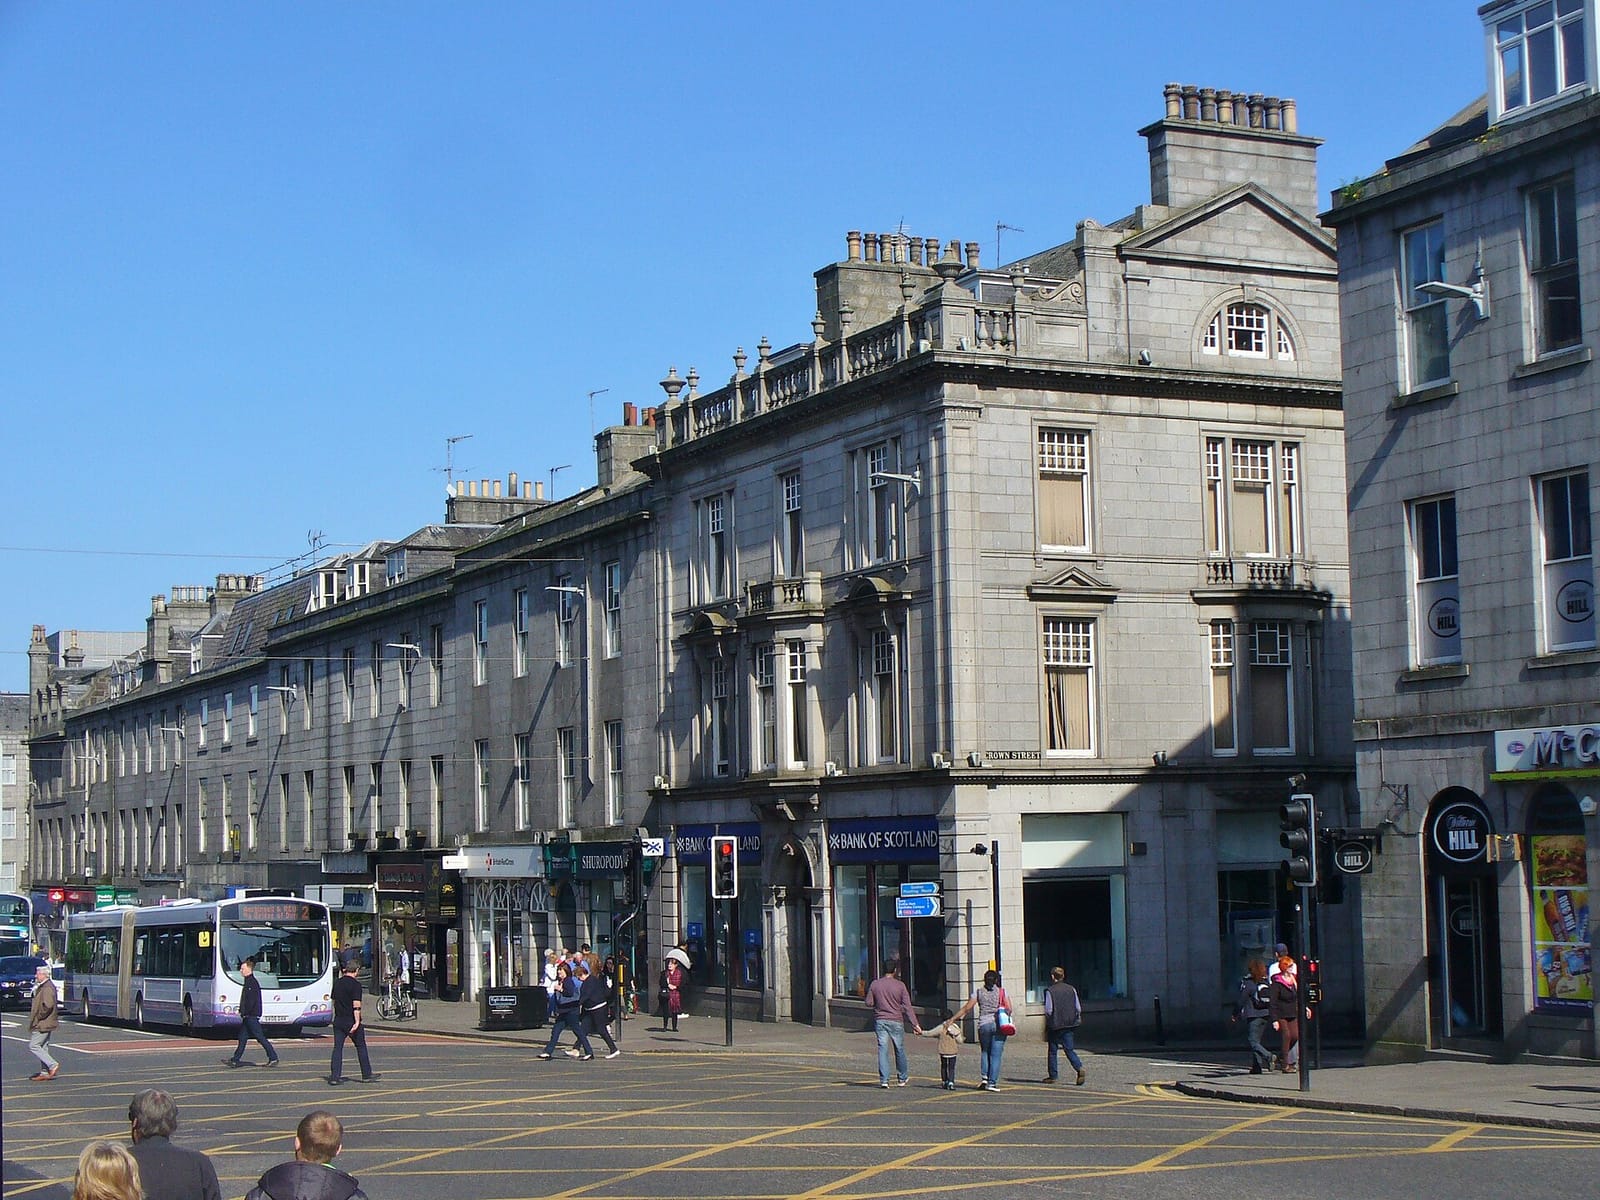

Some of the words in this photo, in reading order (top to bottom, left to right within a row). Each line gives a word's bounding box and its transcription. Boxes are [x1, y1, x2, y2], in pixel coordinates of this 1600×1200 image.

[1567, 599, 1589, 614] HILL
[1437, 616, 1456, 629] HILL
[1531, 728, 1600, 764] McC
[985, 751, 1010, 760] CROWN
[1011, 751, 1041, 760] STREET
[685, 837, 705, 851] BANK
[840, 832, 868, 849] BANK
[868, 831, 882, 848] OF
[884, 829, 938, 848] SCOTLAND
[1449, 830, 1478, 850] HILL
[1344, 856, 1362, 866] HILL
[301, 906, 309, 920] 2
